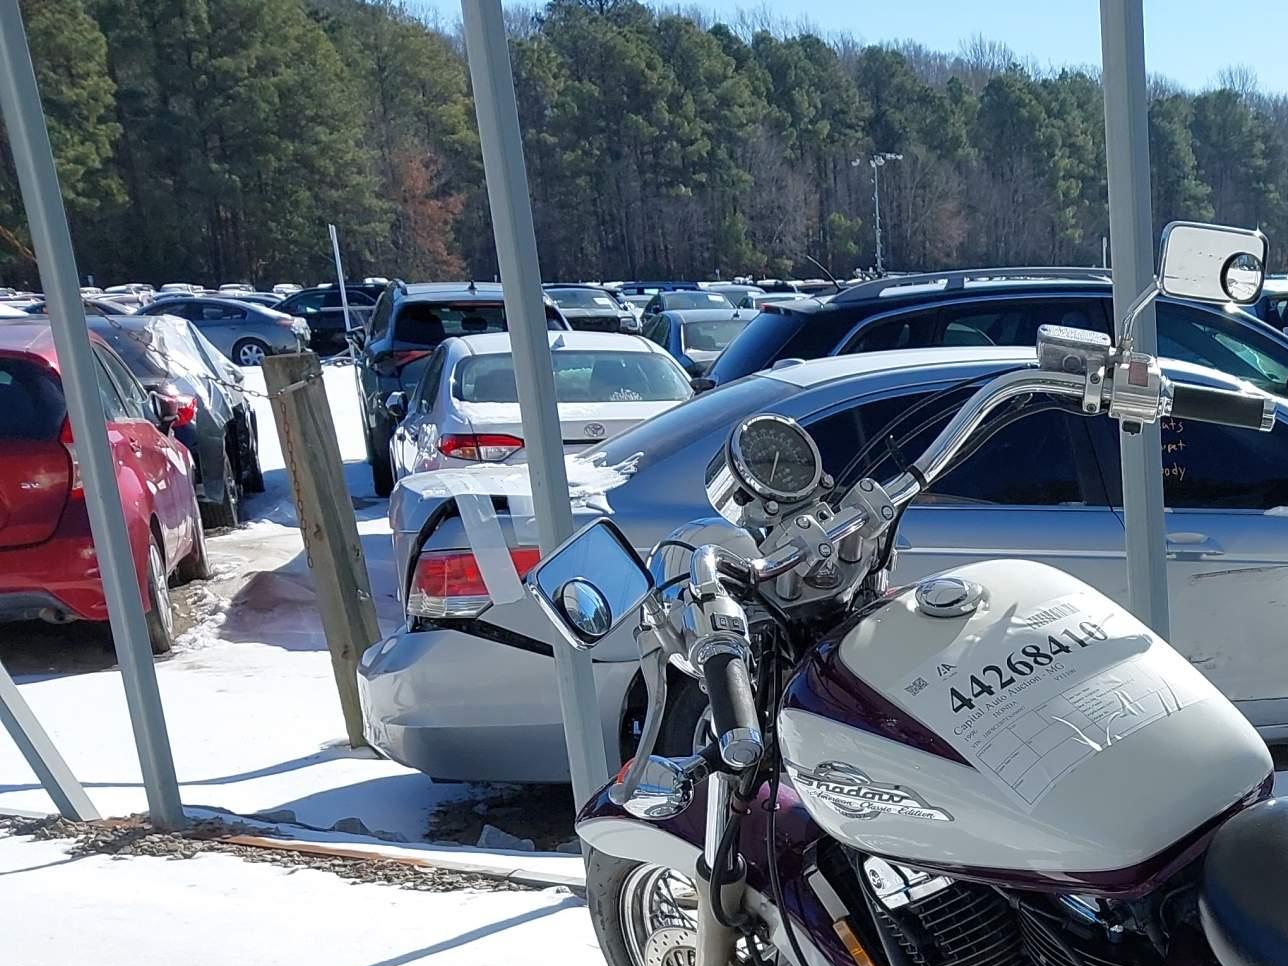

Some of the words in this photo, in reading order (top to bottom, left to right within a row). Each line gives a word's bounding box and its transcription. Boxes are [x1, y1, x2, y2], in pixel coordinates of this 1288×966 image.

[1162, 418, 1184, 433] ats
[1163, 462, 1186, 481] ody
[949, 621, 1108, 714] 44268410
[953, 708, 985, 736] Capital
[985, 695, 1008, 711] Auto
[1007, 675, 1042, 697] Auction
[1045, 662, 1065, 675] MG
[793, 772, 911, 803] Shadow
[806, 789, 853, 806] American
[860, 800, 892, 813] Classic
[897, 806, 935, 819] Edition
